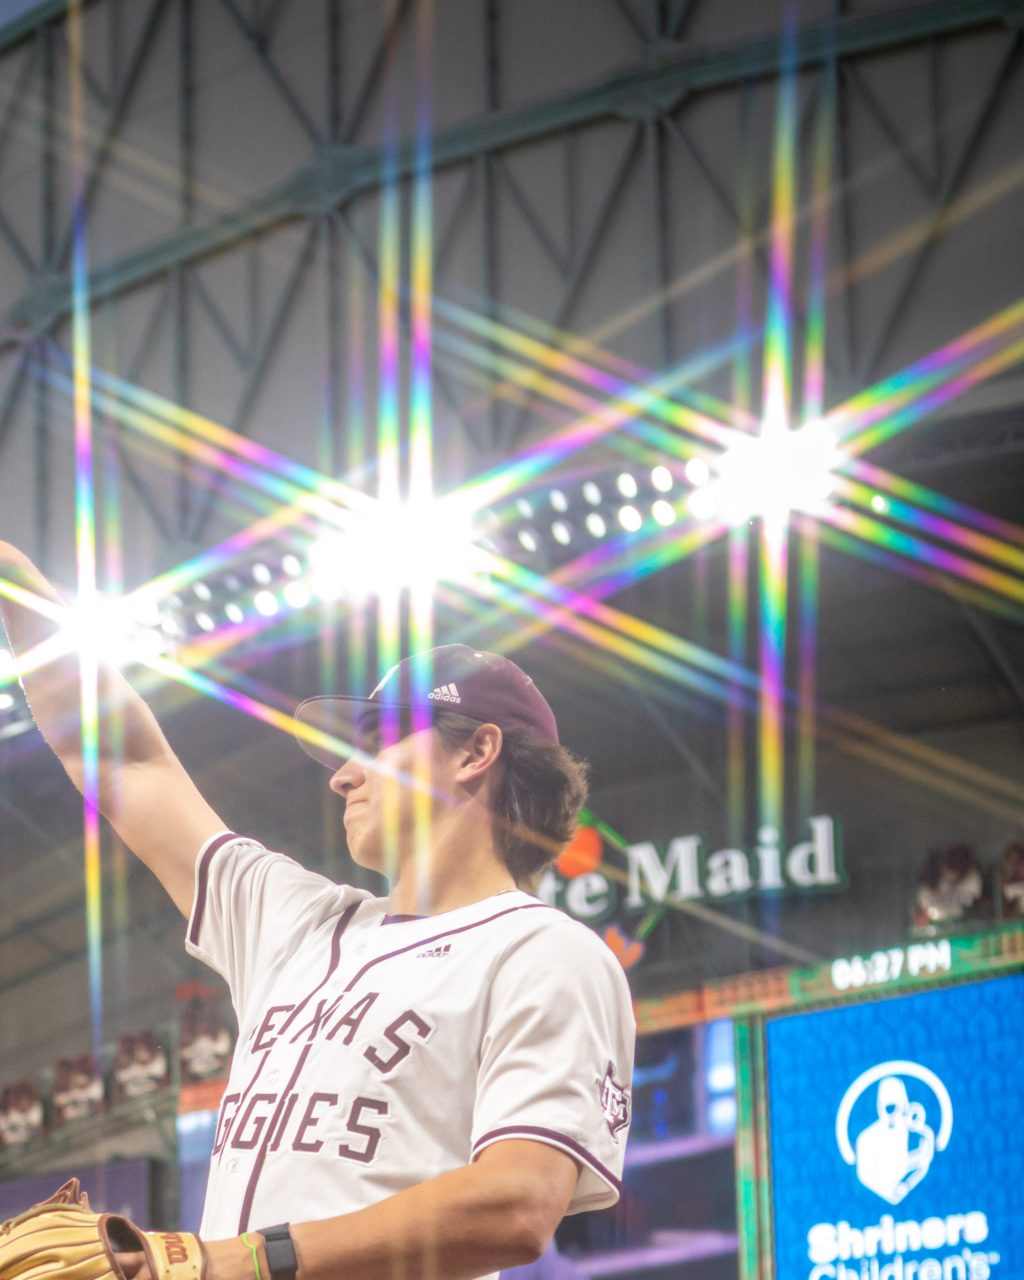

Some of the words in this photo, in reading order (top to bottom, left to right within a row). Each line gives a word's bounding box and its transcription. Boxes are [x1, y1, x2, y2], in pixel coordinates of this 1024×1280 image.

[428, 691, 462, 704] adidas
[625, 815, 840, 908] Maid
[832, 952, 902, 990] 06:27
[907, 938, 951, 977] PM
[249, 991, 433, 1074] EXAS
[212, 1091, 390, 1165] GGIES
[807, 1210, 989, 1264] Shriners
